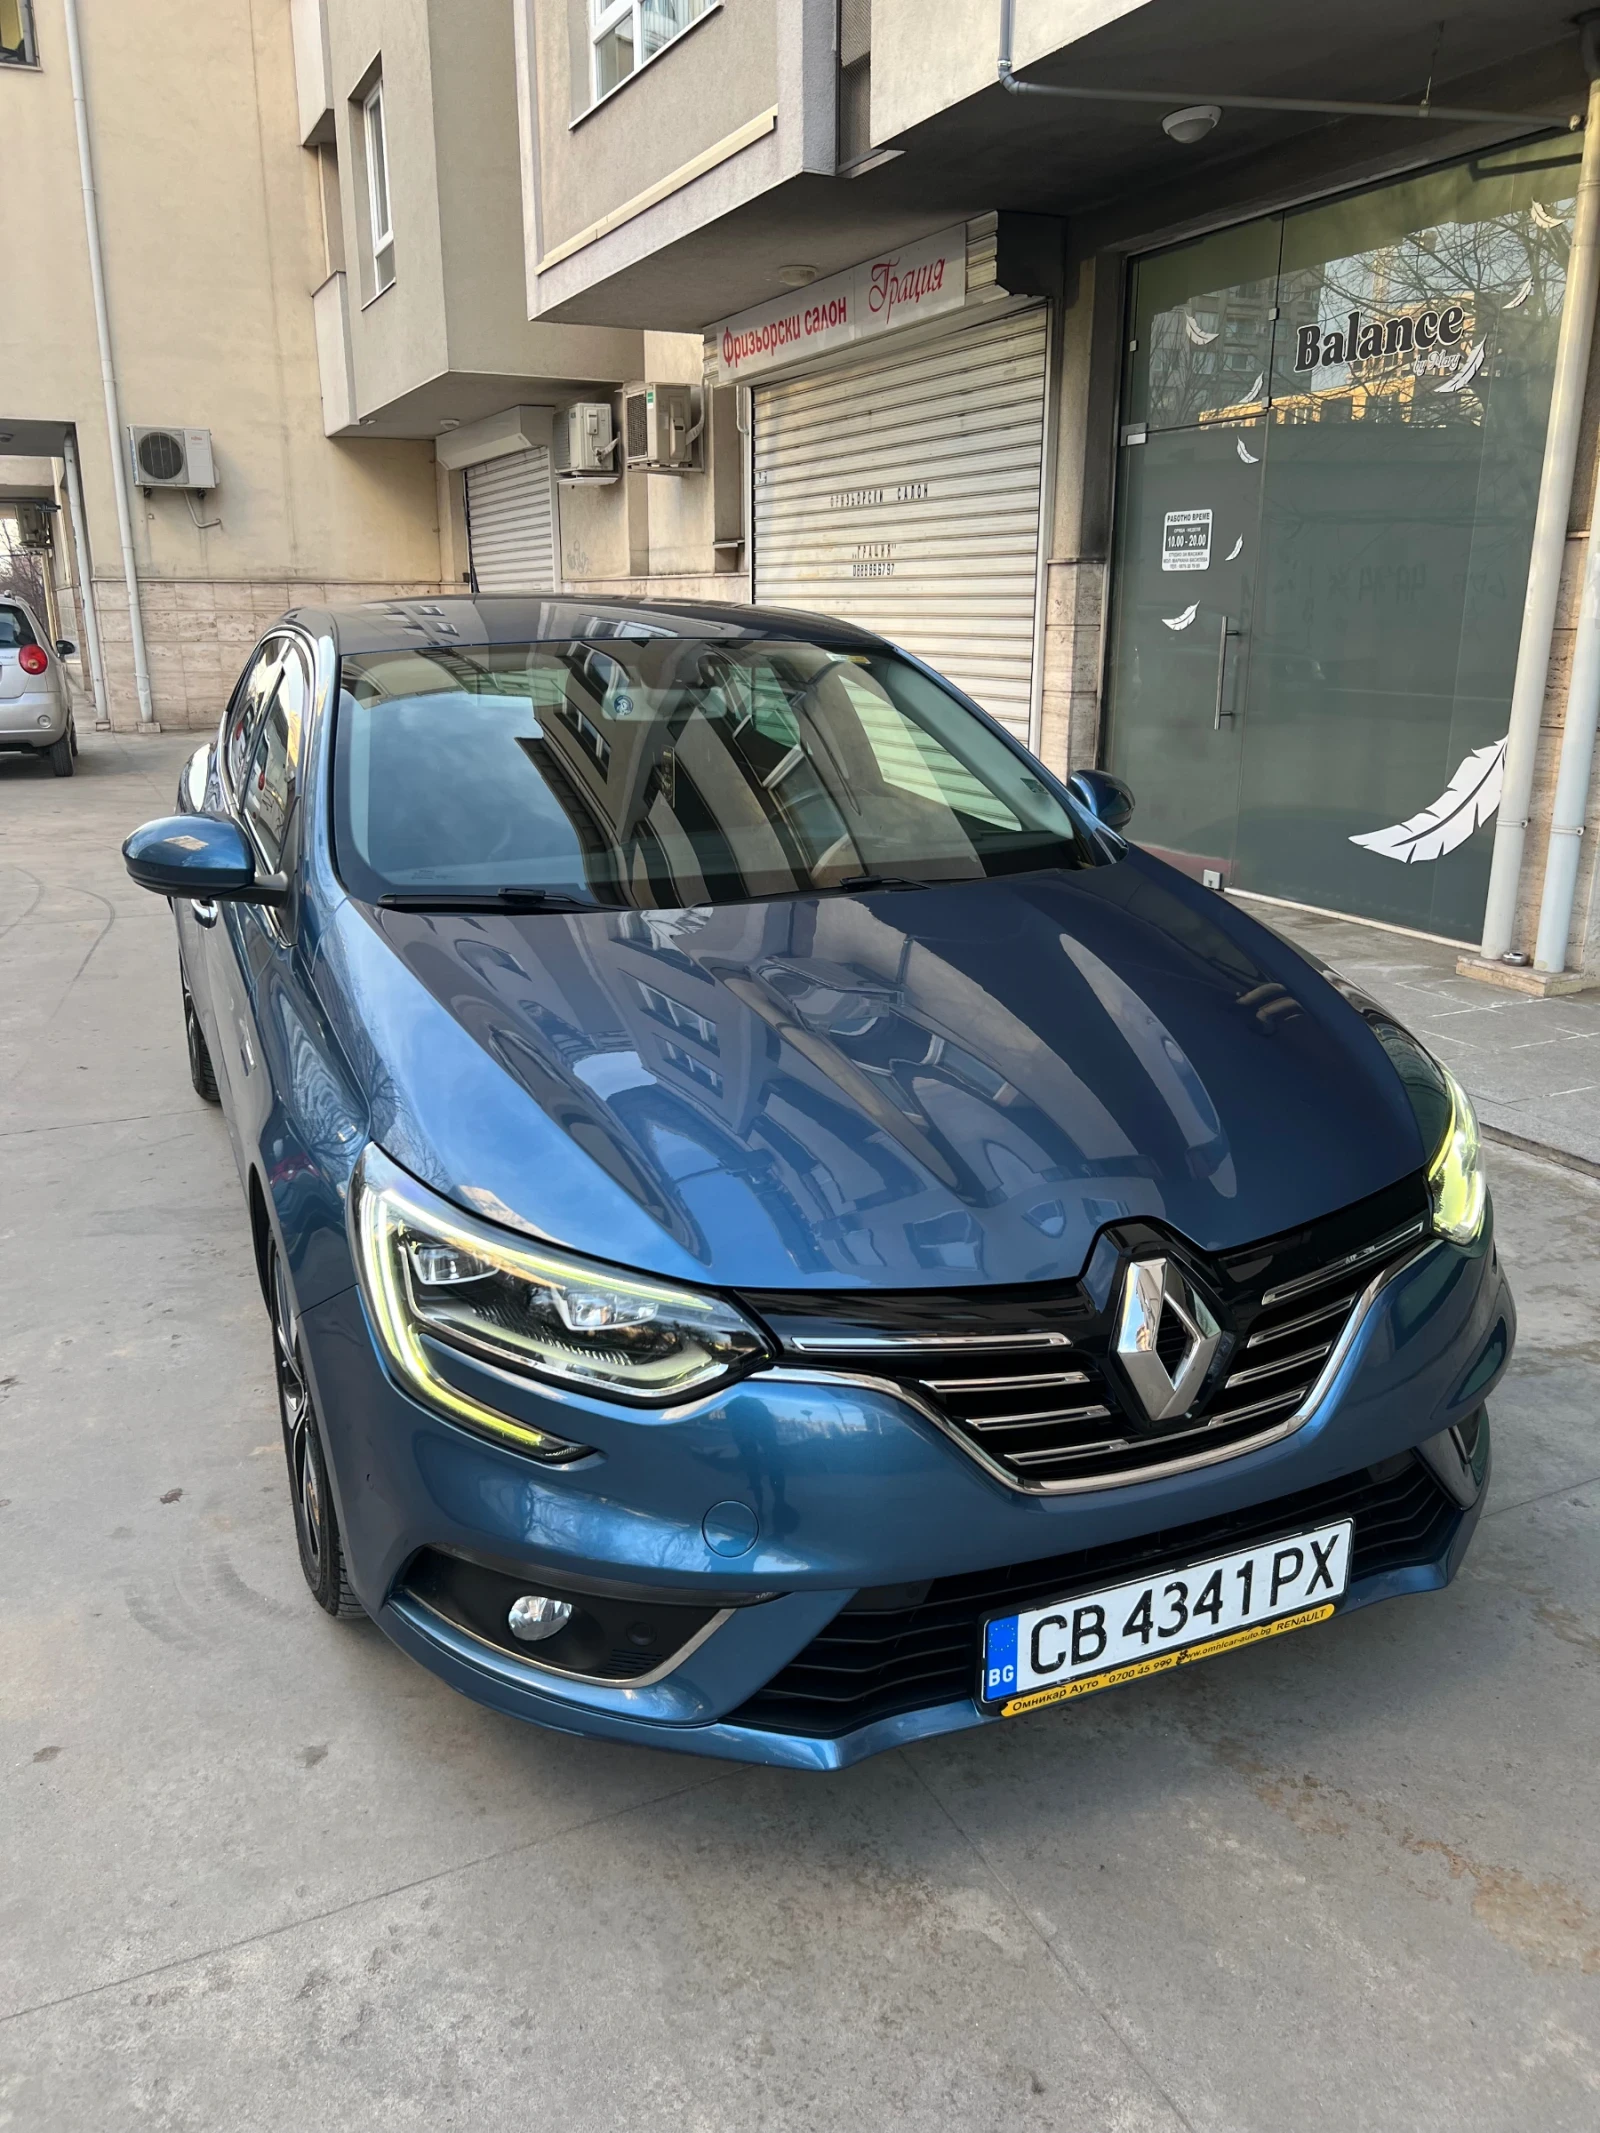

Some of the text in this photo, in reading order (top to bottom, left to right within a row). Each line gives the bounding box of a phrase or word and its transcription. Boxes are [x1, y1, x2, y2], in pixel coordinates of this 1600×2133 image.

[722, 256, 946, 368] Фризьорски салон Грация
[1293, 306, 1466, 373] Balance
[1412, 349, 1462, 377] by Mary
[897, 483, 928, 501] САЛОН
[1167, 512, 1211, 523] РАБОТНО ВРЕМЕ
[1168, 535, 1185, 548] 10.00
[1188, 534, 1207, 547] 20.00
[1030, 1533, 1340, 1675] CB 4341 PX
[1012, 1688, 1067, 1712] Омникар
[1069, 1680, 1099, 1695] Ауто
[1108, 1669, 1135, 1684] 0700
[1136, 1665, 1150, 1675] 45
[1153, 1658, 1172, 1671] 999
[1276, 1608, 1327, 1631] RENAULT
[988, 1664, 1014, 1688] BG
